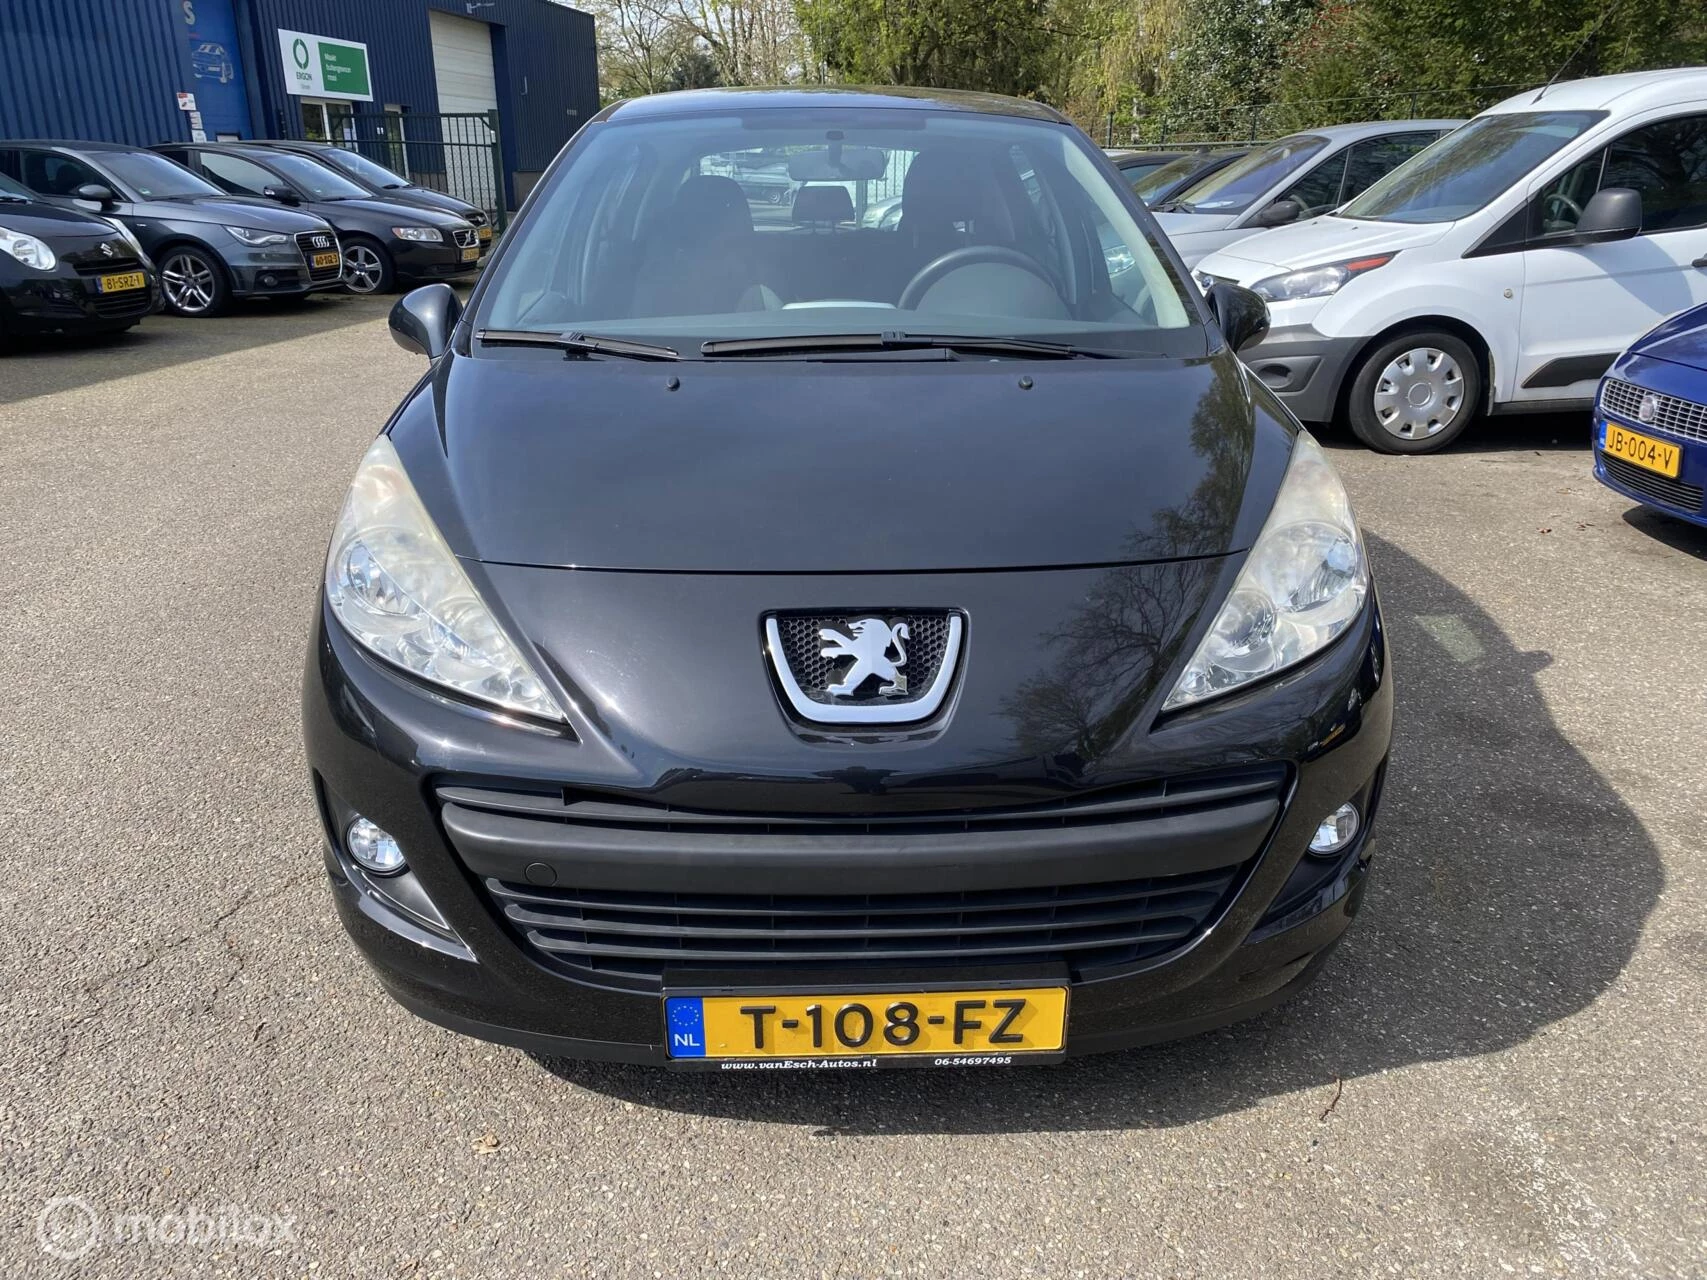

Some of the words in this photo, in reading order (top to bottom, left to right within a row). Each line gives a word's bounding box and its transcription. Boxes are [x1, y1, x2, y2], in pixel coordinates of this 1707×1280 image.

[296, 72, 313, 81] ERGON
[106, 274, 141, 290] 81-SRZ-1
[1608, 429, 1674, 470] JB-004-V
[740, 998, 1026, 1050] T-108-FZ
[674, 1033, 701, 1047] NL
[720, 1057, 878, 1071] www.vanEsch-Autos.nl
[934, 1056, 1013, 1067] 06-54697495
